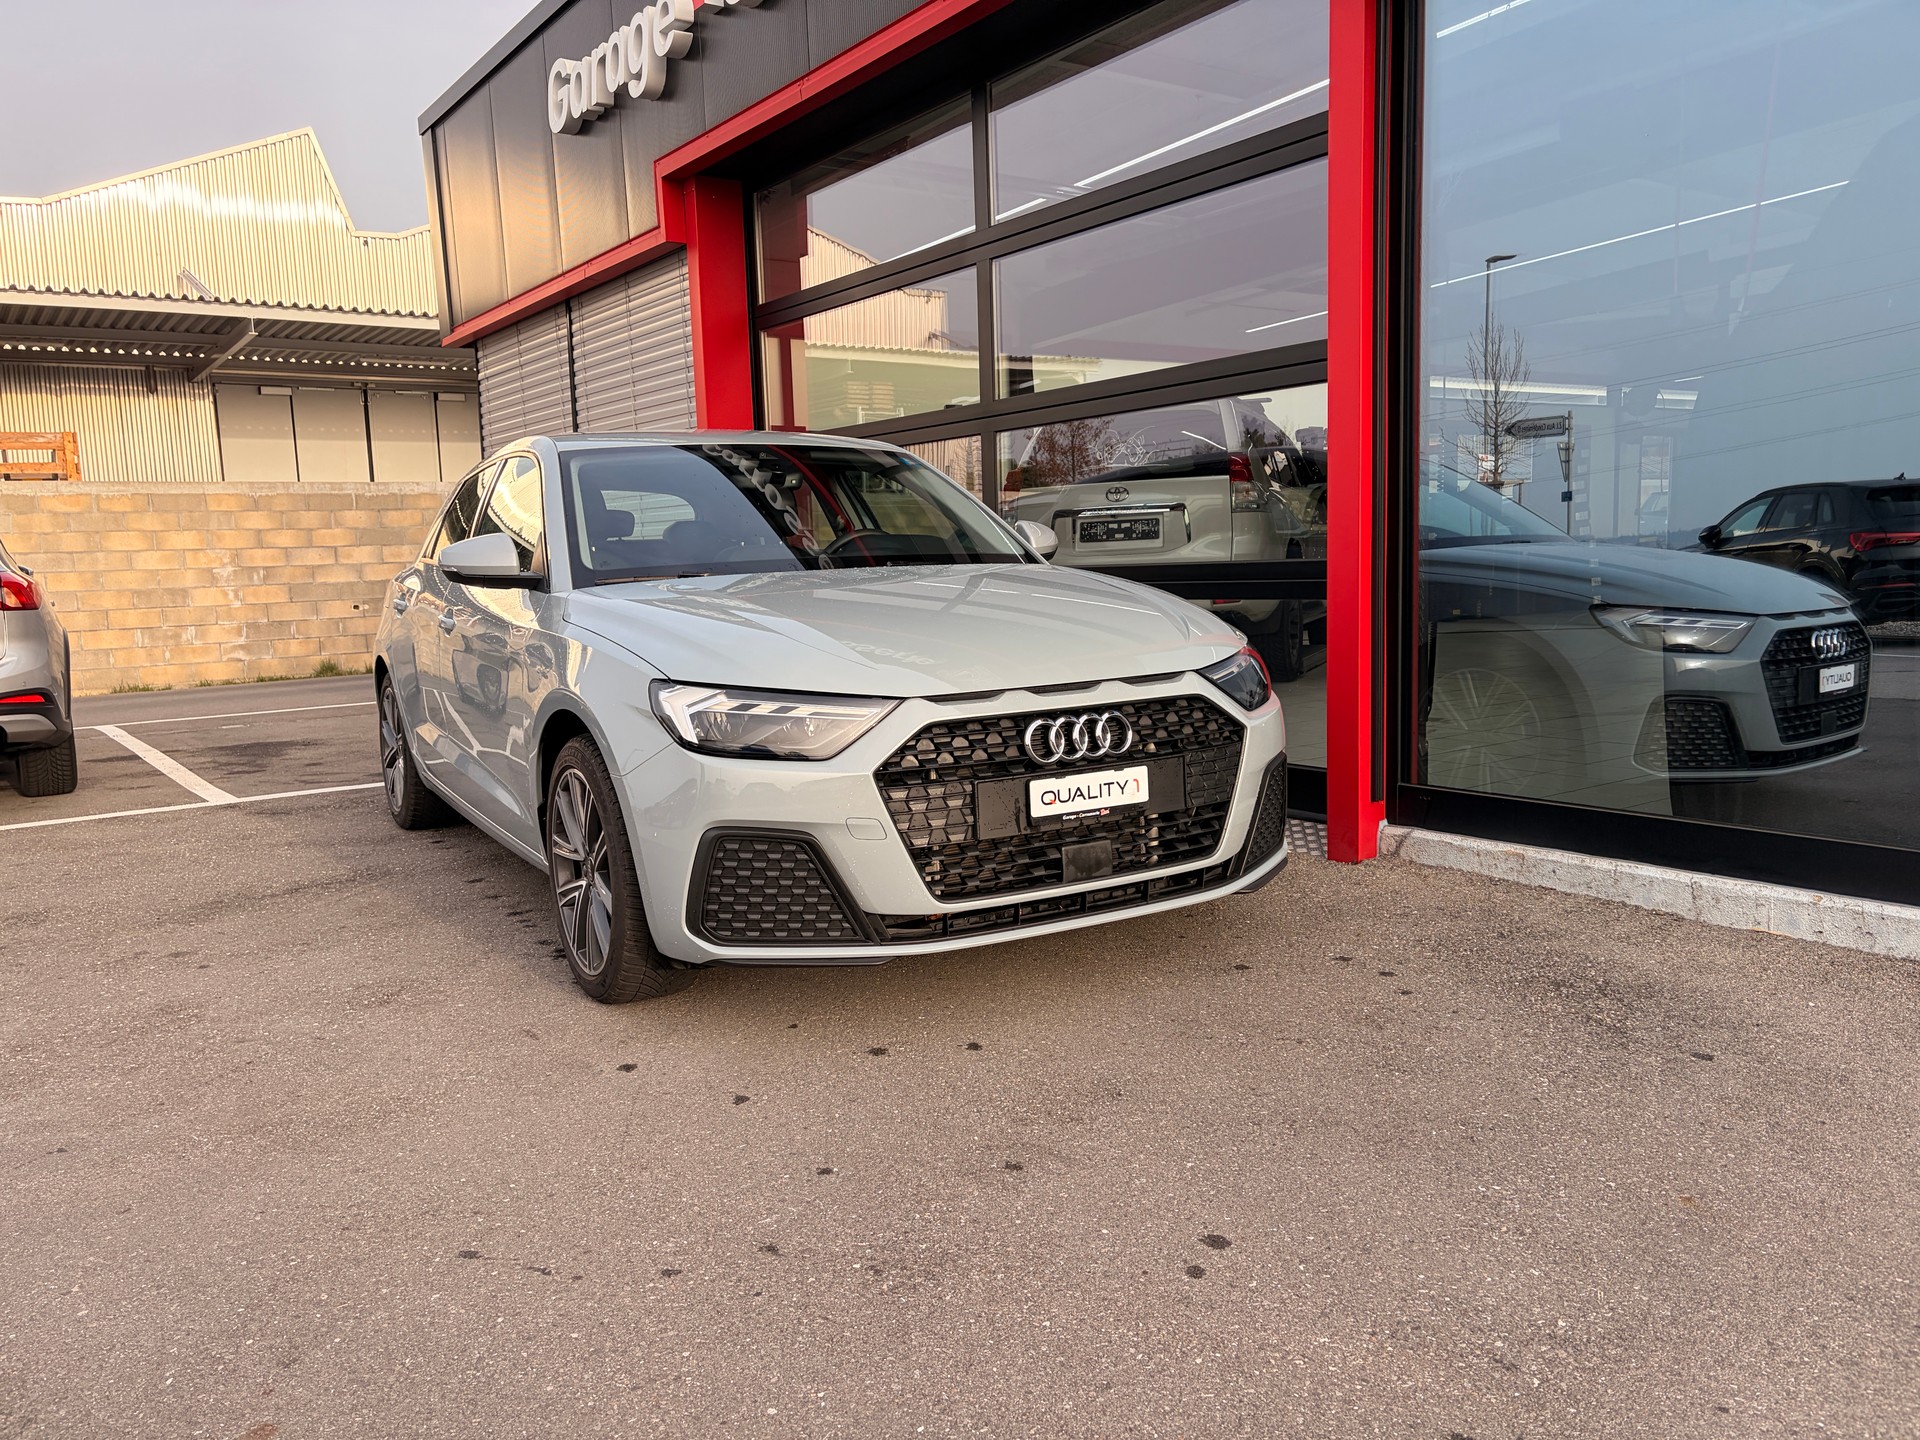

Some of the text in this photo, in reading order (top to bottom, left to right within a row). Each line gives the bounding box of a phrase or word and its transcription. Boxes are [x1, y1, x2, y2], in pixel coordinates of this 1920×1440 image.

[547, 0, 692, 135] Garage
[1041, 778, 1140, 806] QUALITY 1
